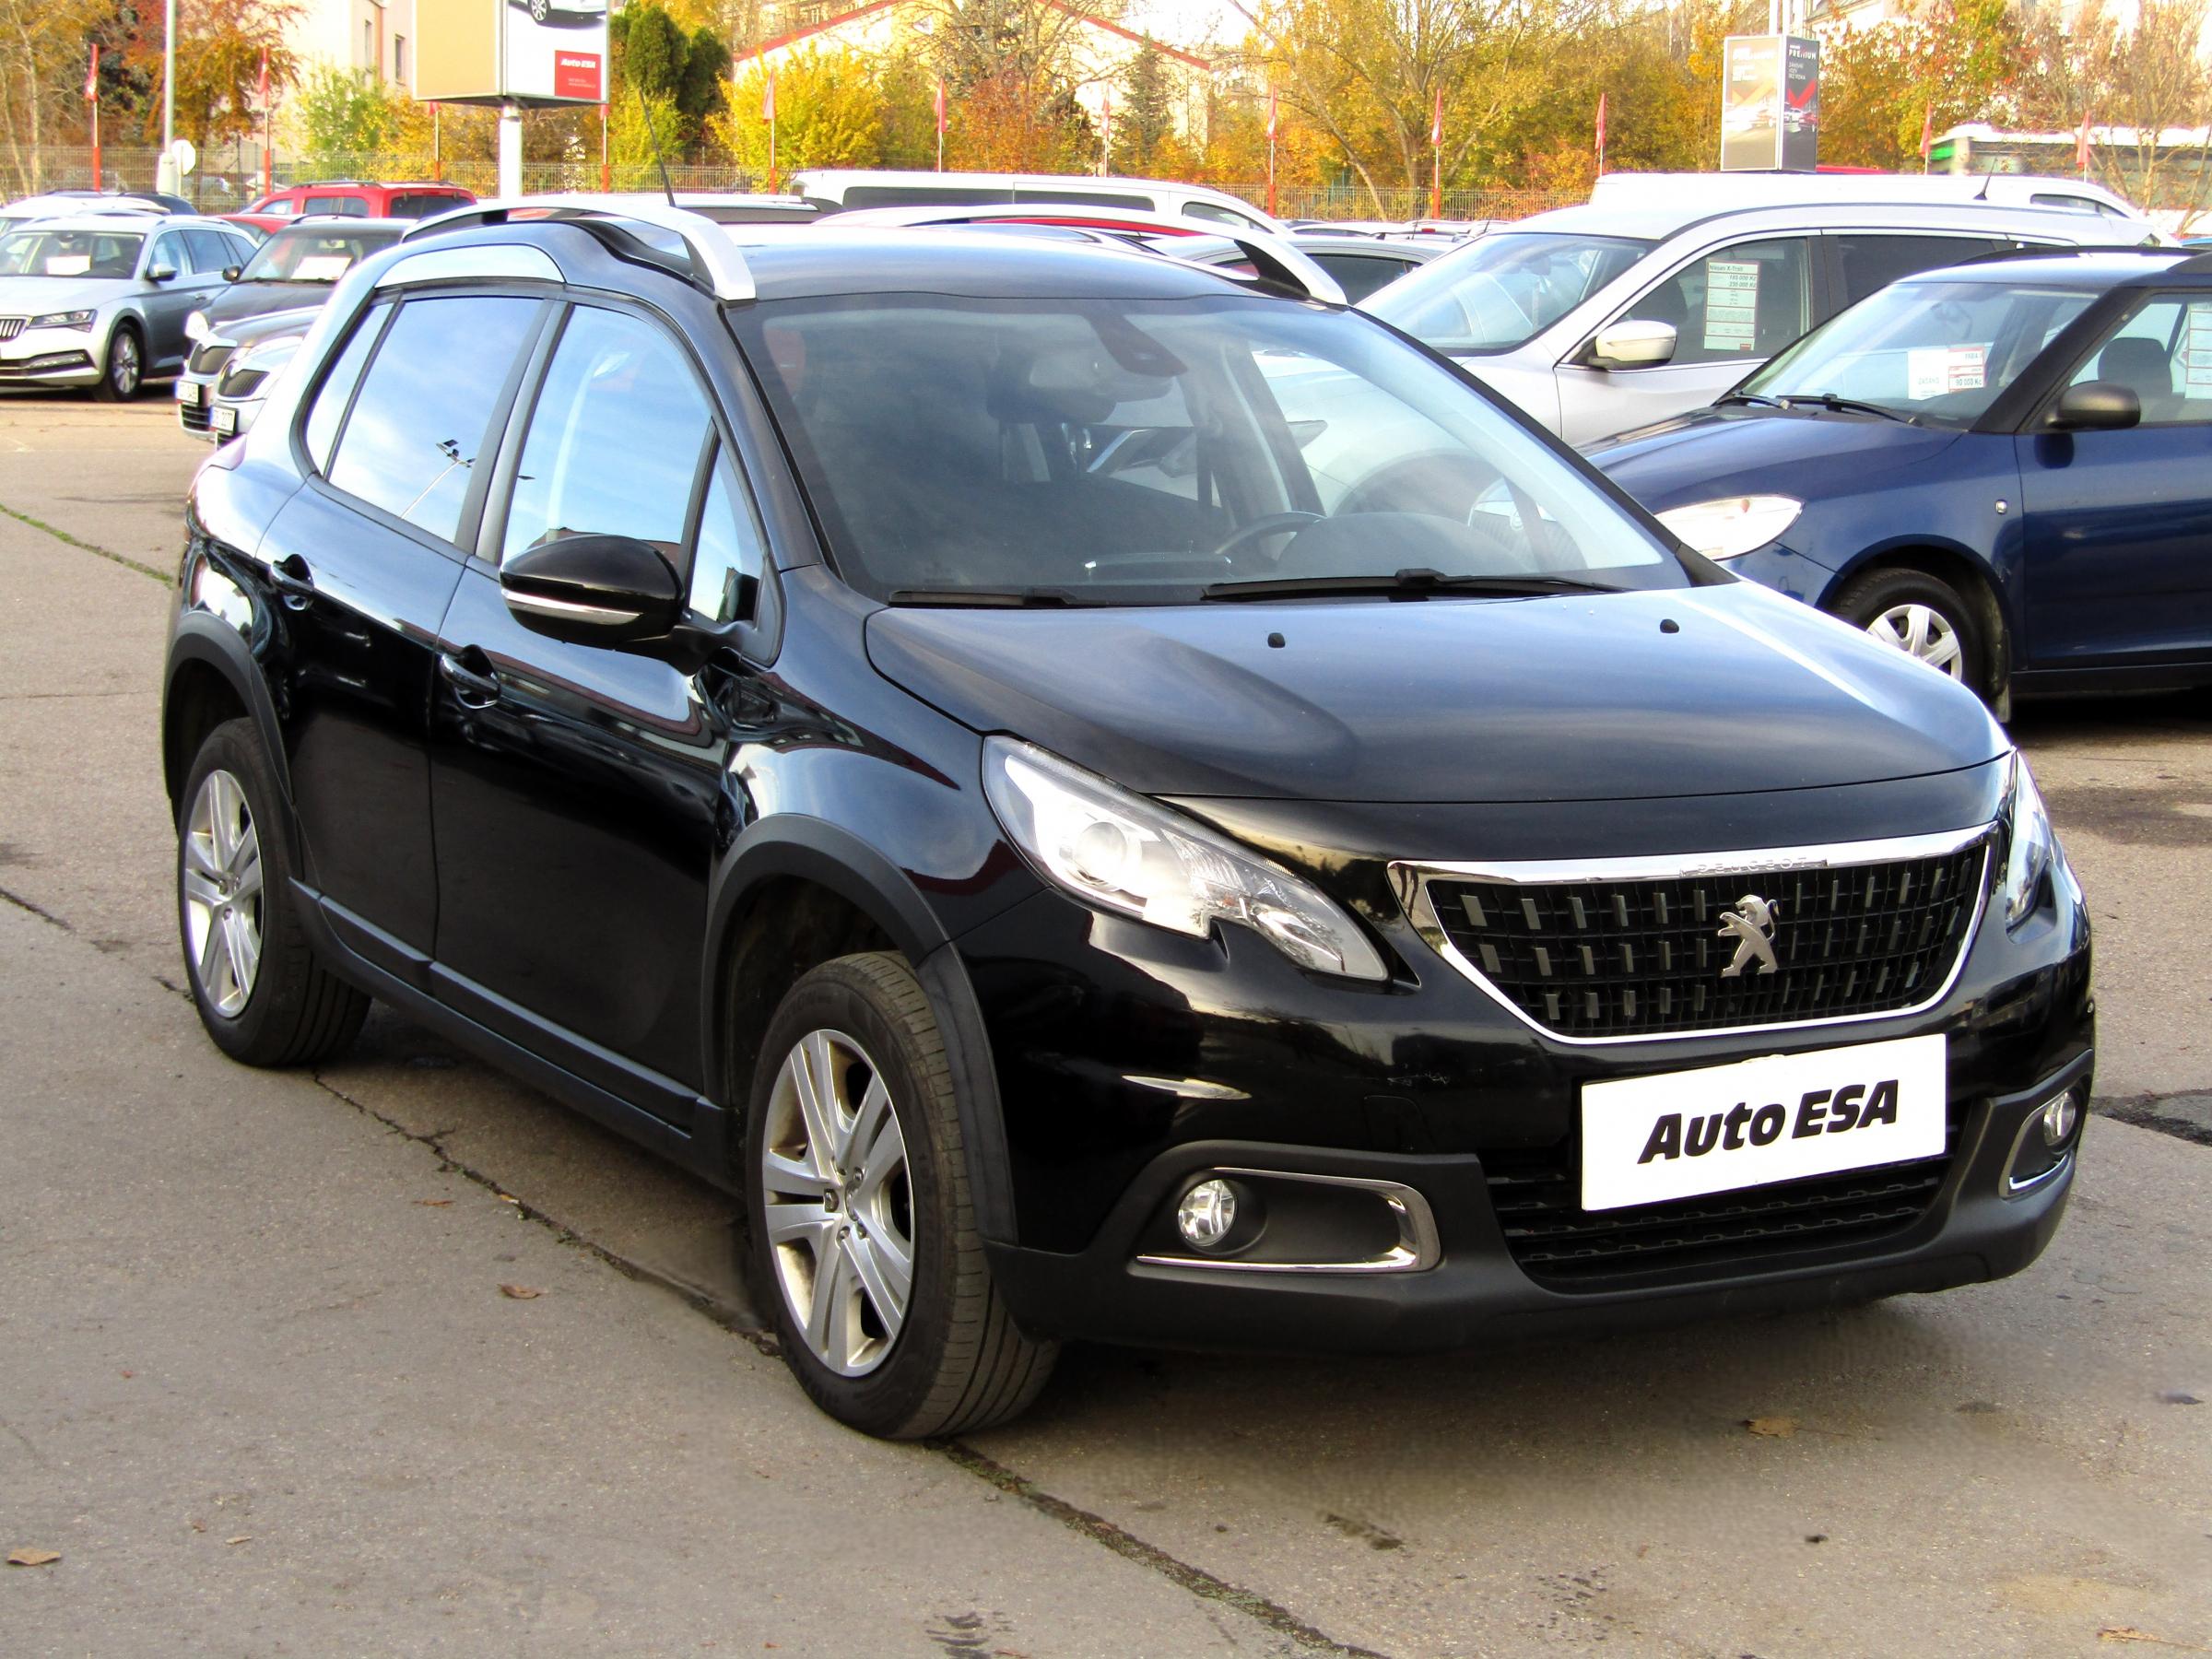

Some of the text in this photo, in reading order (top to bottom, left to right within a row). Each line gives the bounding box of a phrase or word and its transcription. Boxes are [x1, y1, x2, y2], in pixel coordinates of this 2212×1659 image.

[1788, 49, 1816, 60] PREMIUM
[560, 58, 581, 67] Auto
[1697, 856, 1807, 876] PEUGEOT
[1637, 1079, 1899, 1164] Auto ESA
